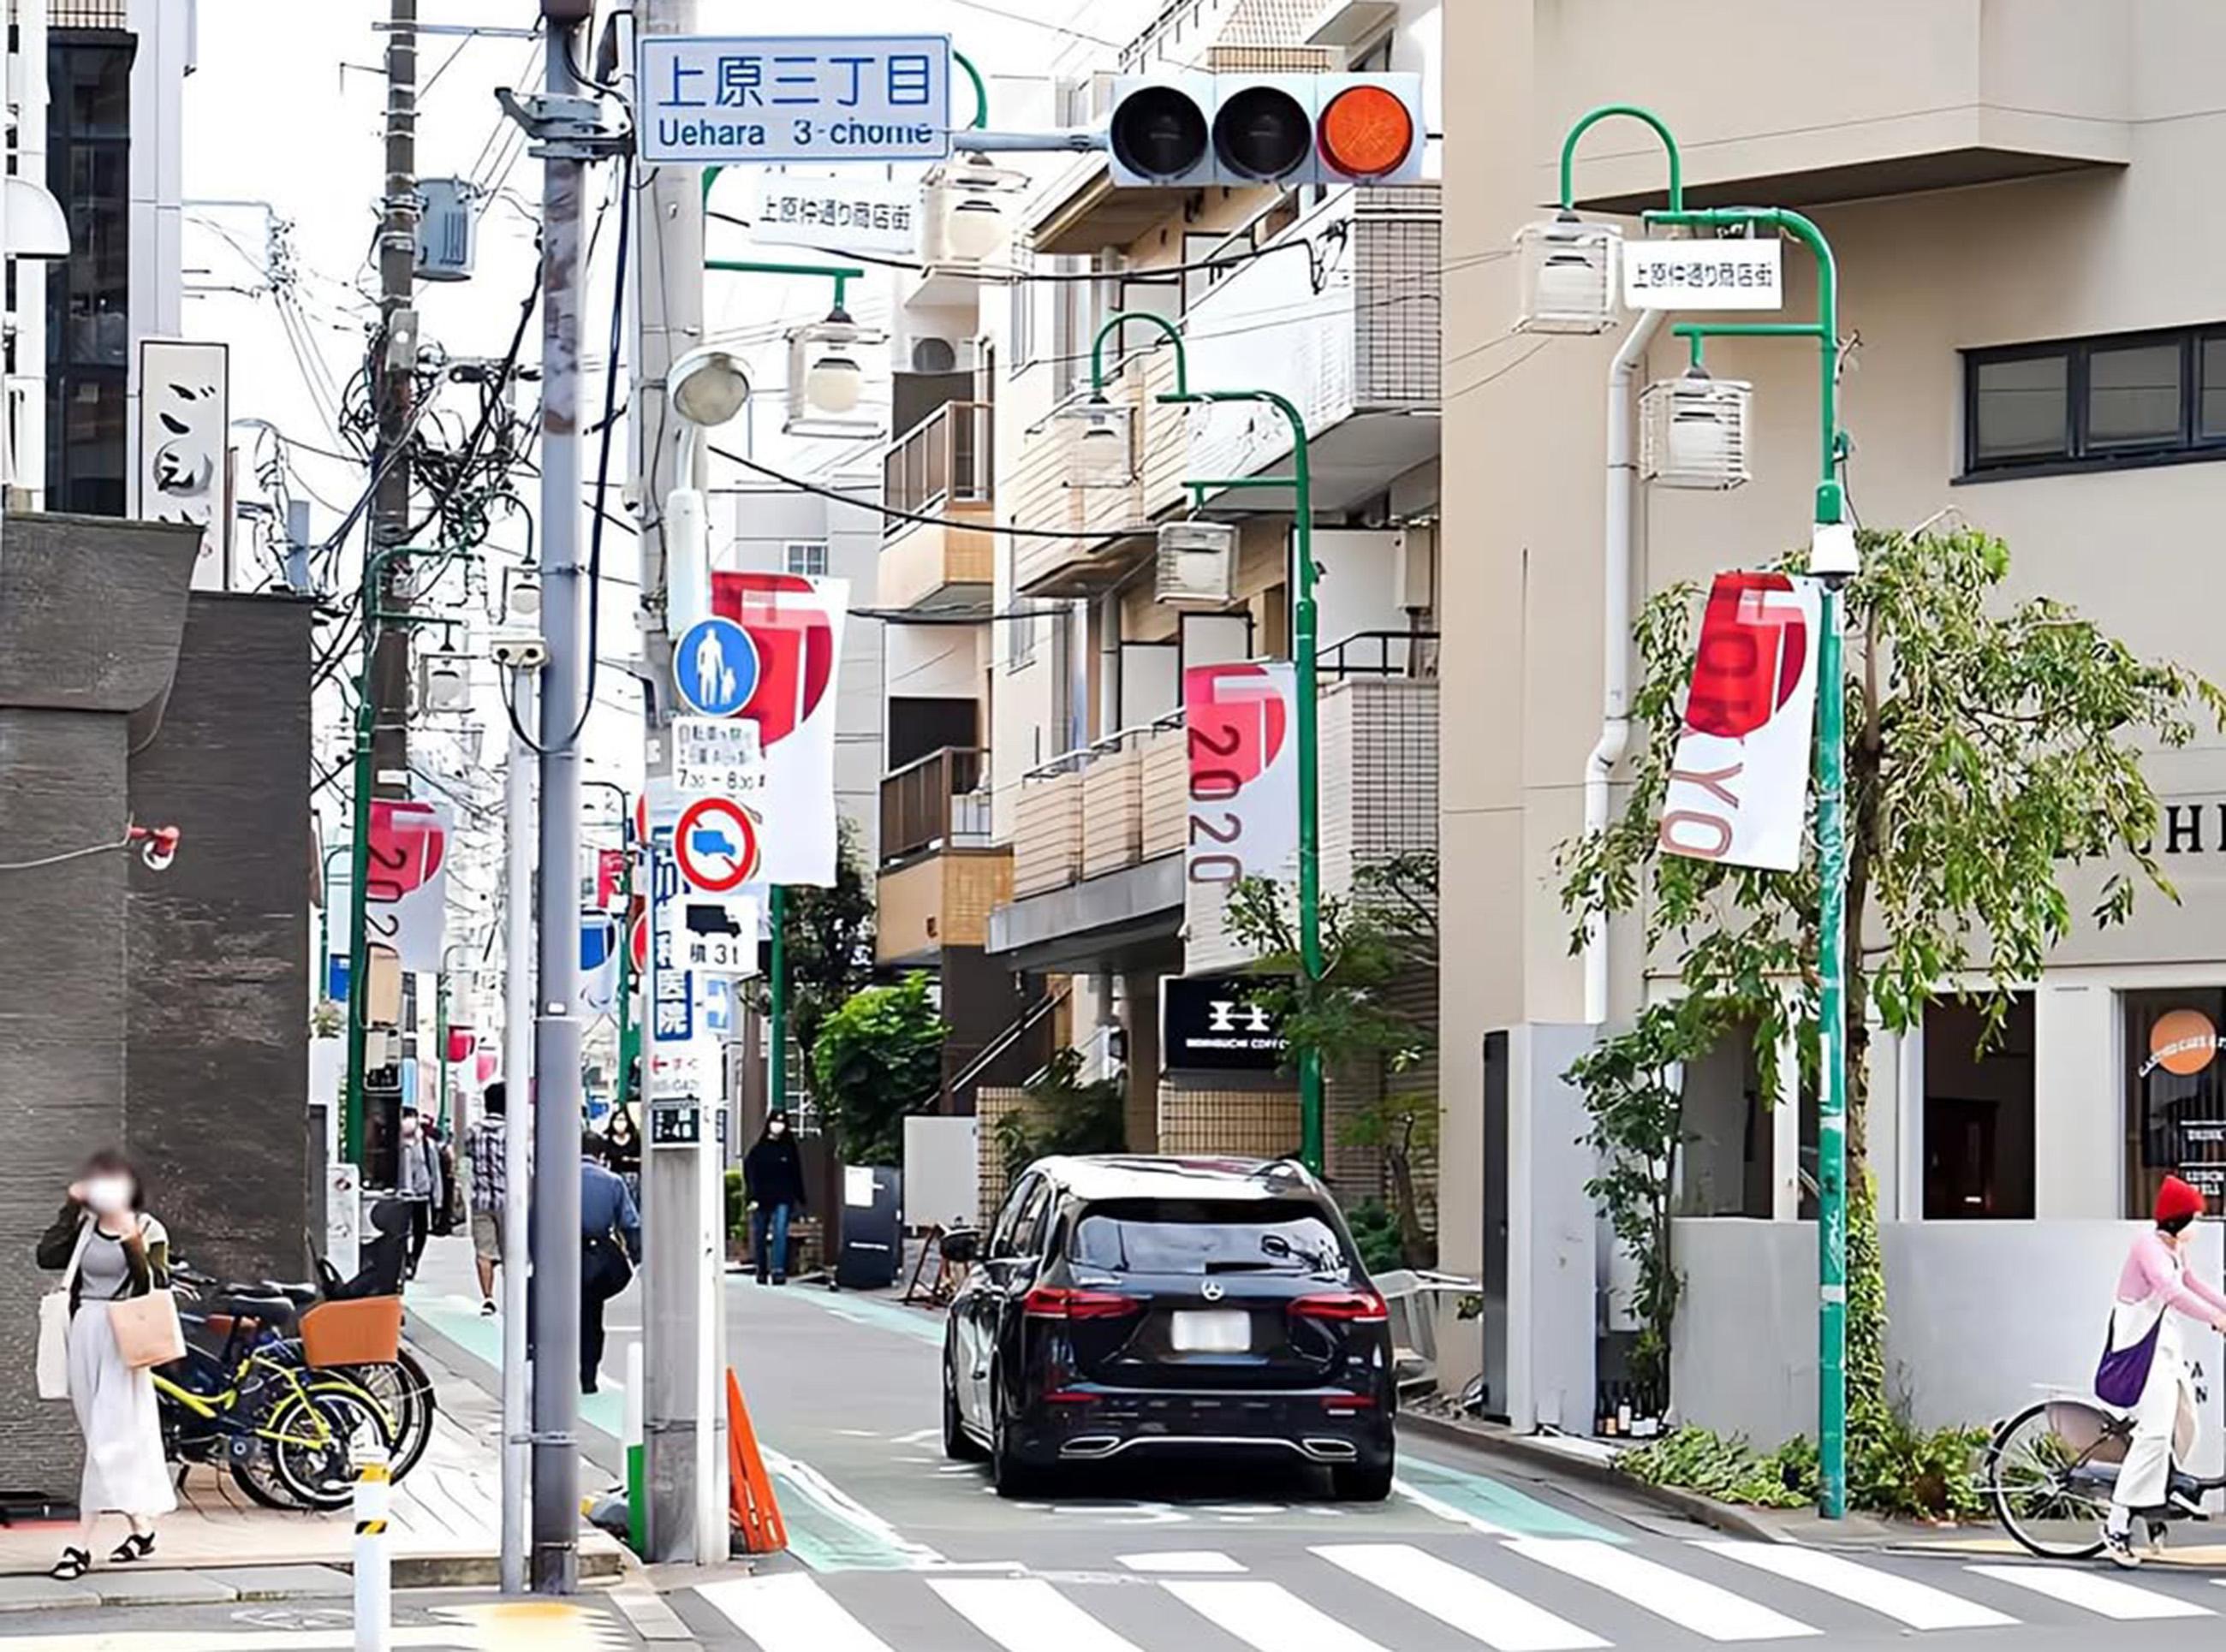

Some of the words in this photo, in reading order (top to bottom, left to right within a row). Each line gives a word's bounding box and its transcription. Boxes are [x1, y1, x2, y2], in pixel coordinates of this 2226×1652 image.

[658, 56, 930, 107] 上原三丁目
[658, 119, 765, 146] Uehara
[794, 116, 932, 146] 3-chome
[1187, 724, 1241, 884] 2020
